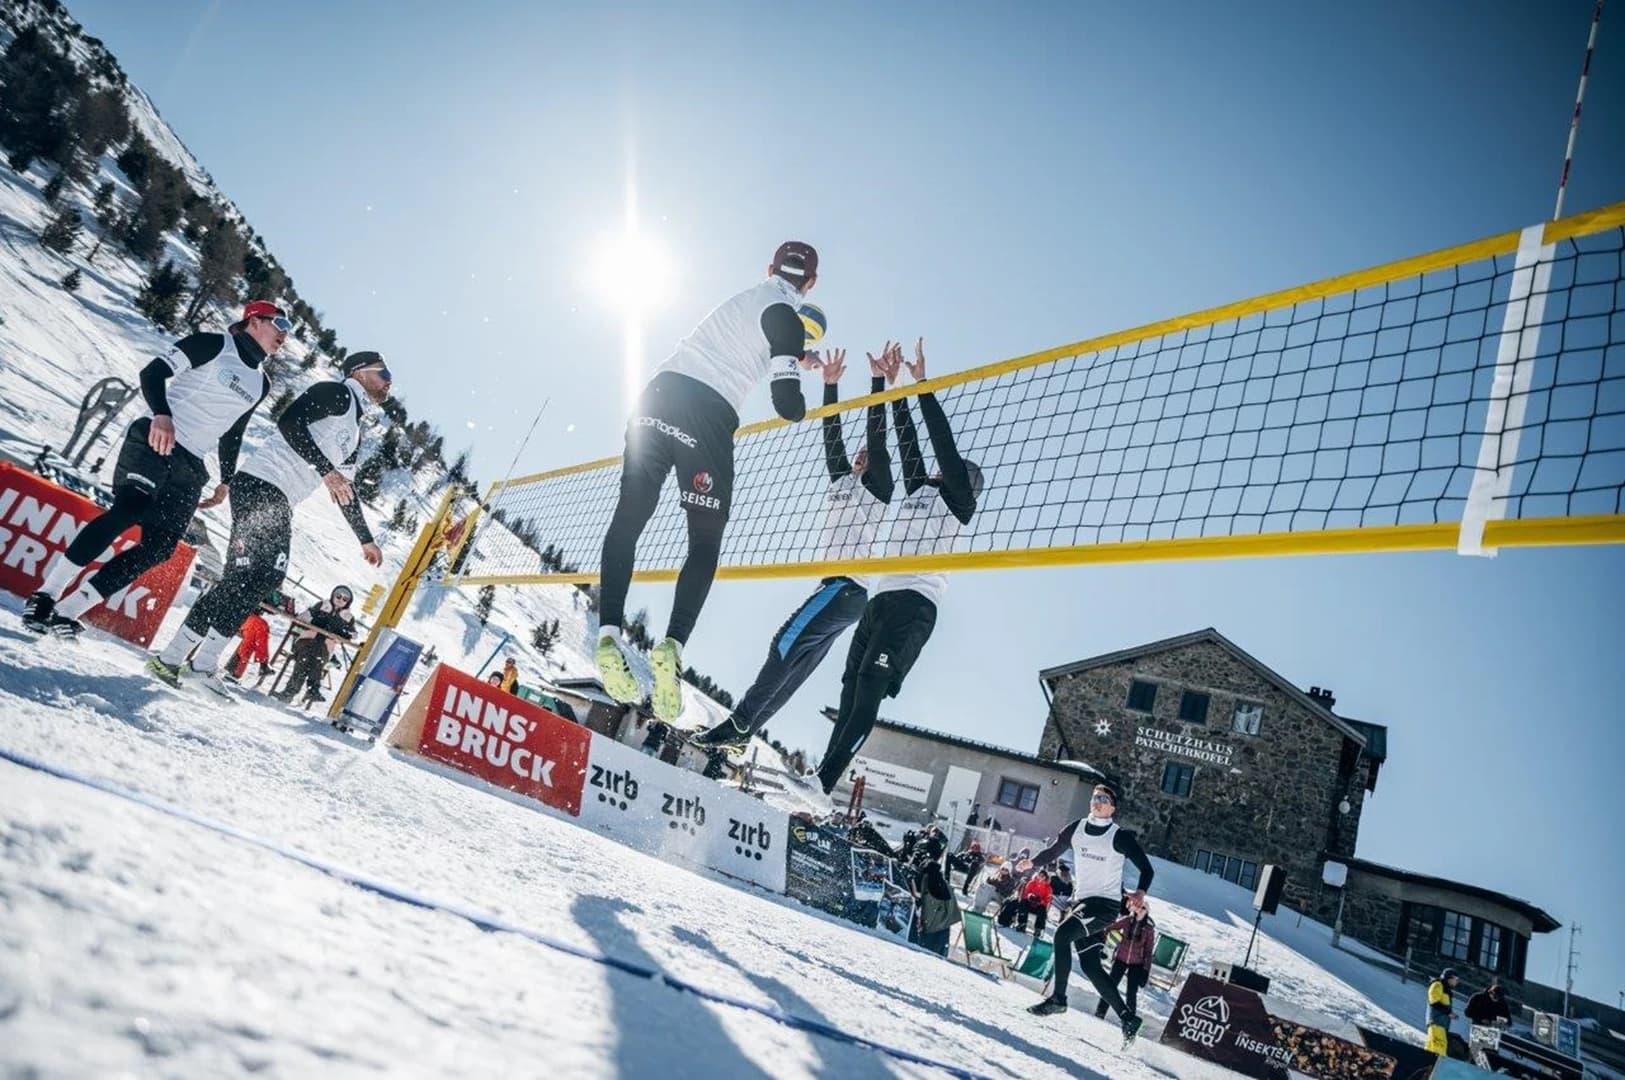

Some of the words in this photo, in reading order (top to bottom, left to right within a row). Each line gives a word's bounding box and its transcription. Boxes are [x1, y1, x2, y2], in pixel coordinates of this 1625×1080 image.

[682, 491, 720, 510] SEISER
[443, 684, 538, 743] INNS'
[435, 714, 556, 788] BRUCK
[1135, 736, 1232, 766] PATSCHERKOFEL
[1137, 726, 1234, 756] SCHUTZHAUS
[590, 764, 638, 800] zirb
[661, 792, 705, 826] zirb
[728, 818, 770, 850] zirb
[1235, 1035, 1294, 1065] INSEKTEN
